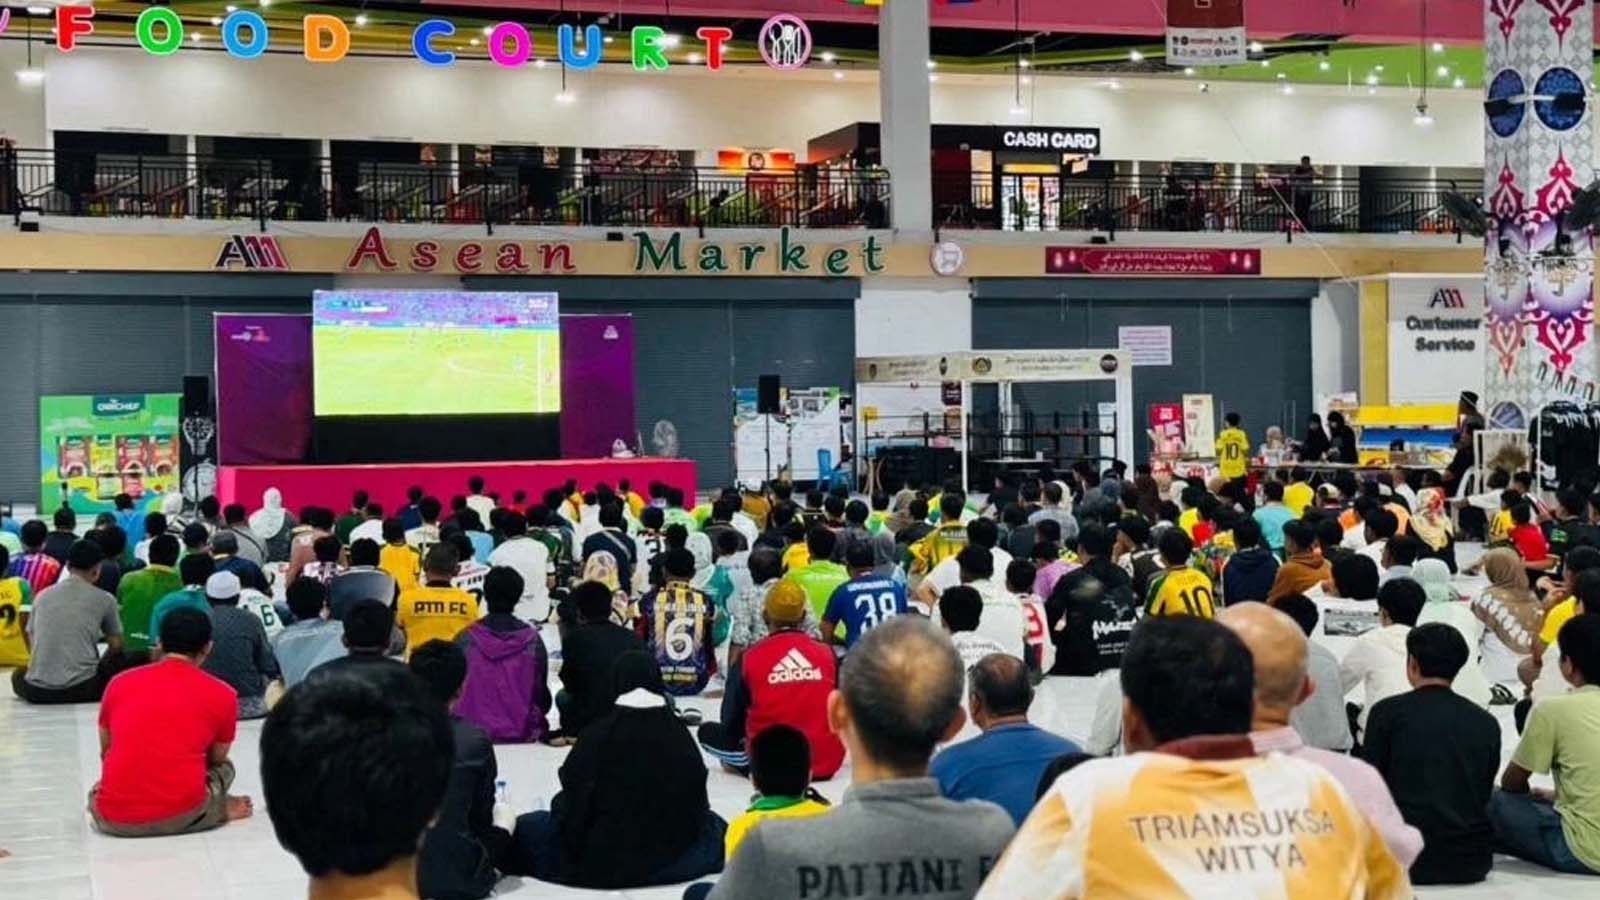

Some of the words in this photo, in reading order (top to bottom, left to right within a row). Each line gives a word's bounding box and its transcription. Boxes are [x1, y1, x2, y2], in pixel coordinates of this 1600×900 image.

[56, 5, 350, 62] FOOD
[411, 19, 733, 71] COURT
[1003, 131, 1048, 148] CASH
[1050, 132, 1097, 149] CARD
[347, 225, 576, 273] Asean
[633, 225, 886, 274] Market
[1406, 315, 1481, 331] Customer
[1415, 336, 1475, 352] Service
[1225, 442, 1240, 461] 10
[449, 602, 468, 615] FC
[855, 592, 897, 634] 38
[1179, 585, 1216, 619] 10
[666, 618, 694, 661] 6
[768, 666, 822, 685] adidas
[1129, 807, 1335, 843] TRIAMSUKSA
[1196, 843, 1306, 873] WITYA
[797, 857, 964, 898] PATTANI
